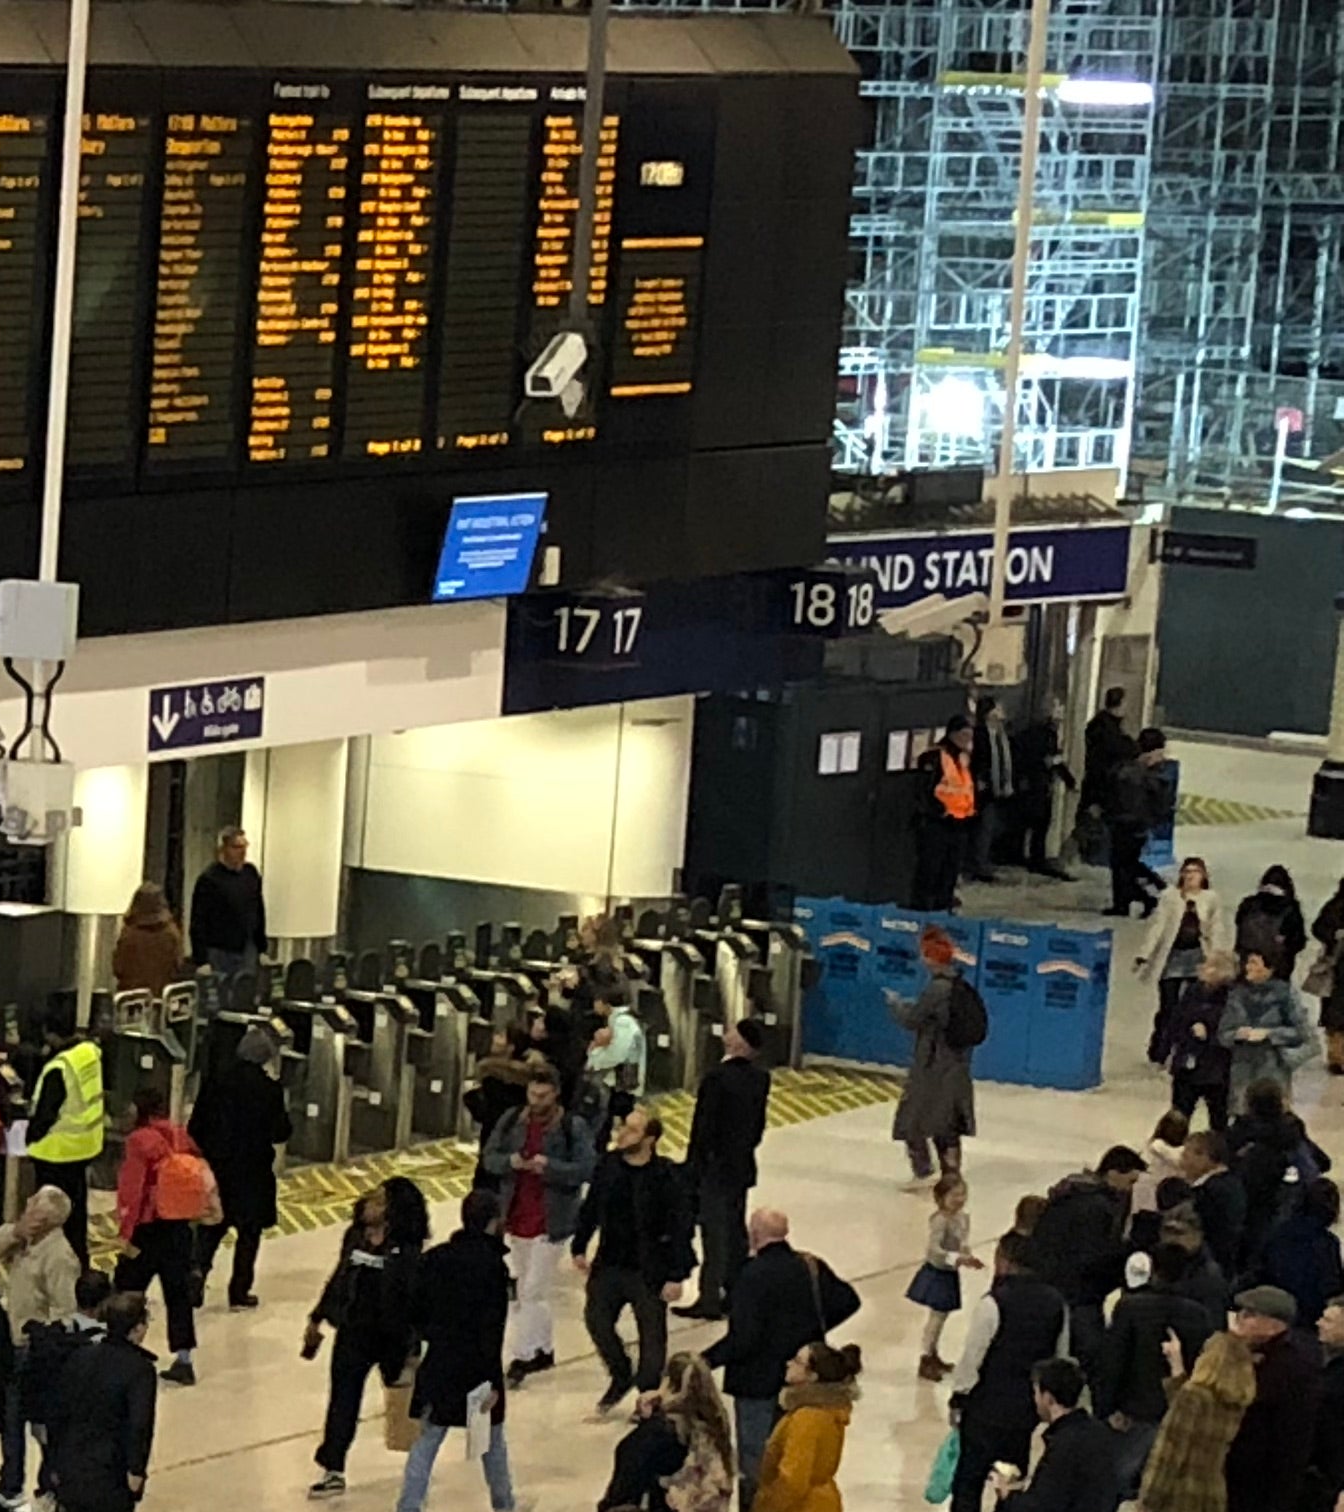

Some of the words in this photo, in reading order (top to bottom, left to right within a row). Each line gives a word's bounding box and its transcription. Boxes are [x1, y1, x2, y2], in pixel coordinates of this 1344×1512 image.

[924, 546, 1053, 589] STATON
[791, 582, 835, 626] 18
[848, 583, 873, 626] 18
[555, 607, 600, 652] 17
[614, 608, 641, 653] 17
